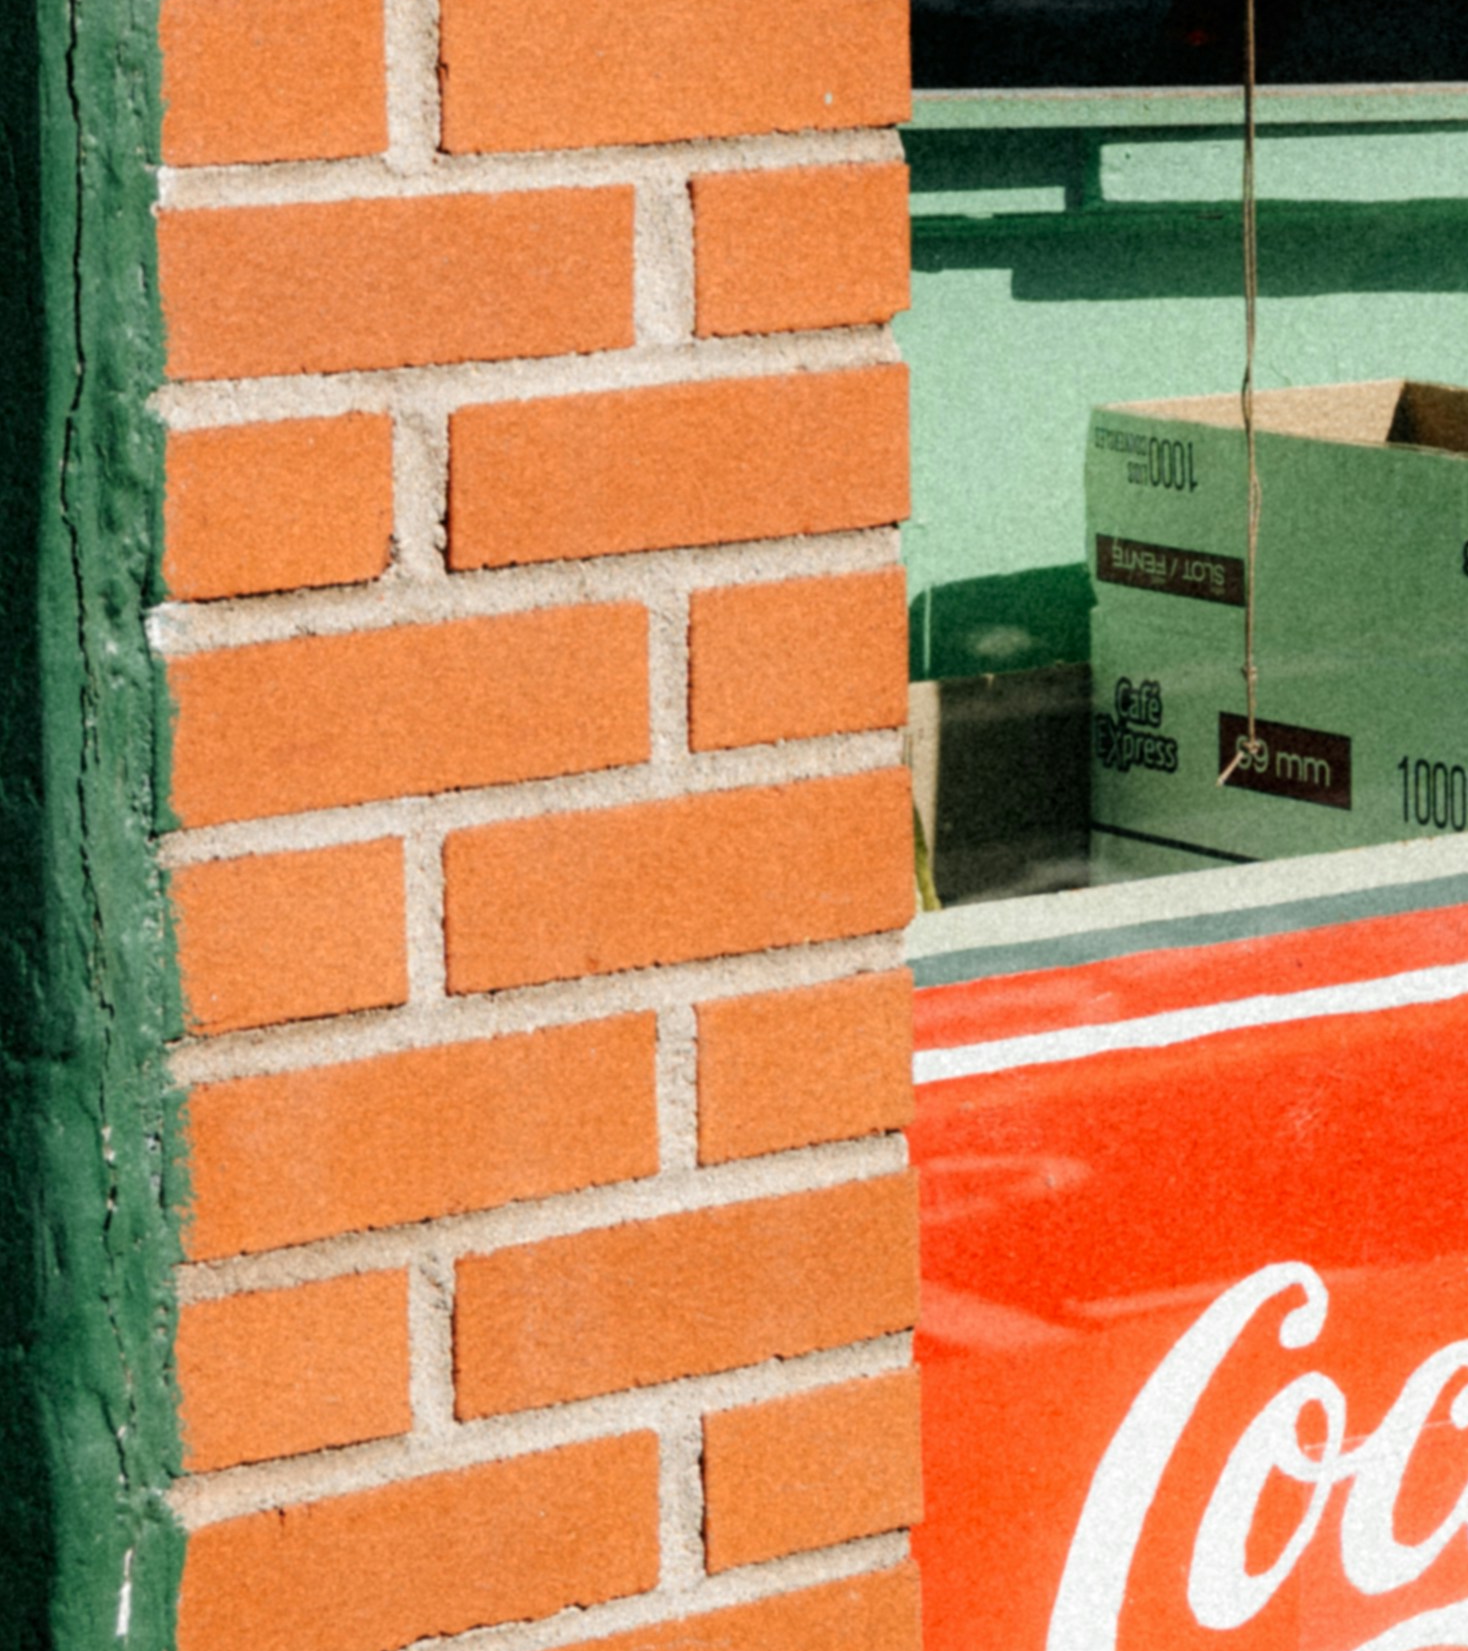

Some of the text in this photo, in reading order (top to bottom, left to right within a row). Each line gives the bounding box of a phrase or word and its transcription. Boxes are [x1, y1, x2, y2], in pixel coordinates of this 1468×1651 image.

[1148, 436, 1198, 493] 1000
[1182, 558, 1226, 586] SLOT
[1115, 676, 1163, 728] Café
[1275, 751, 1331, 787] mm
[1397, 755, 1467, 833] 1000
